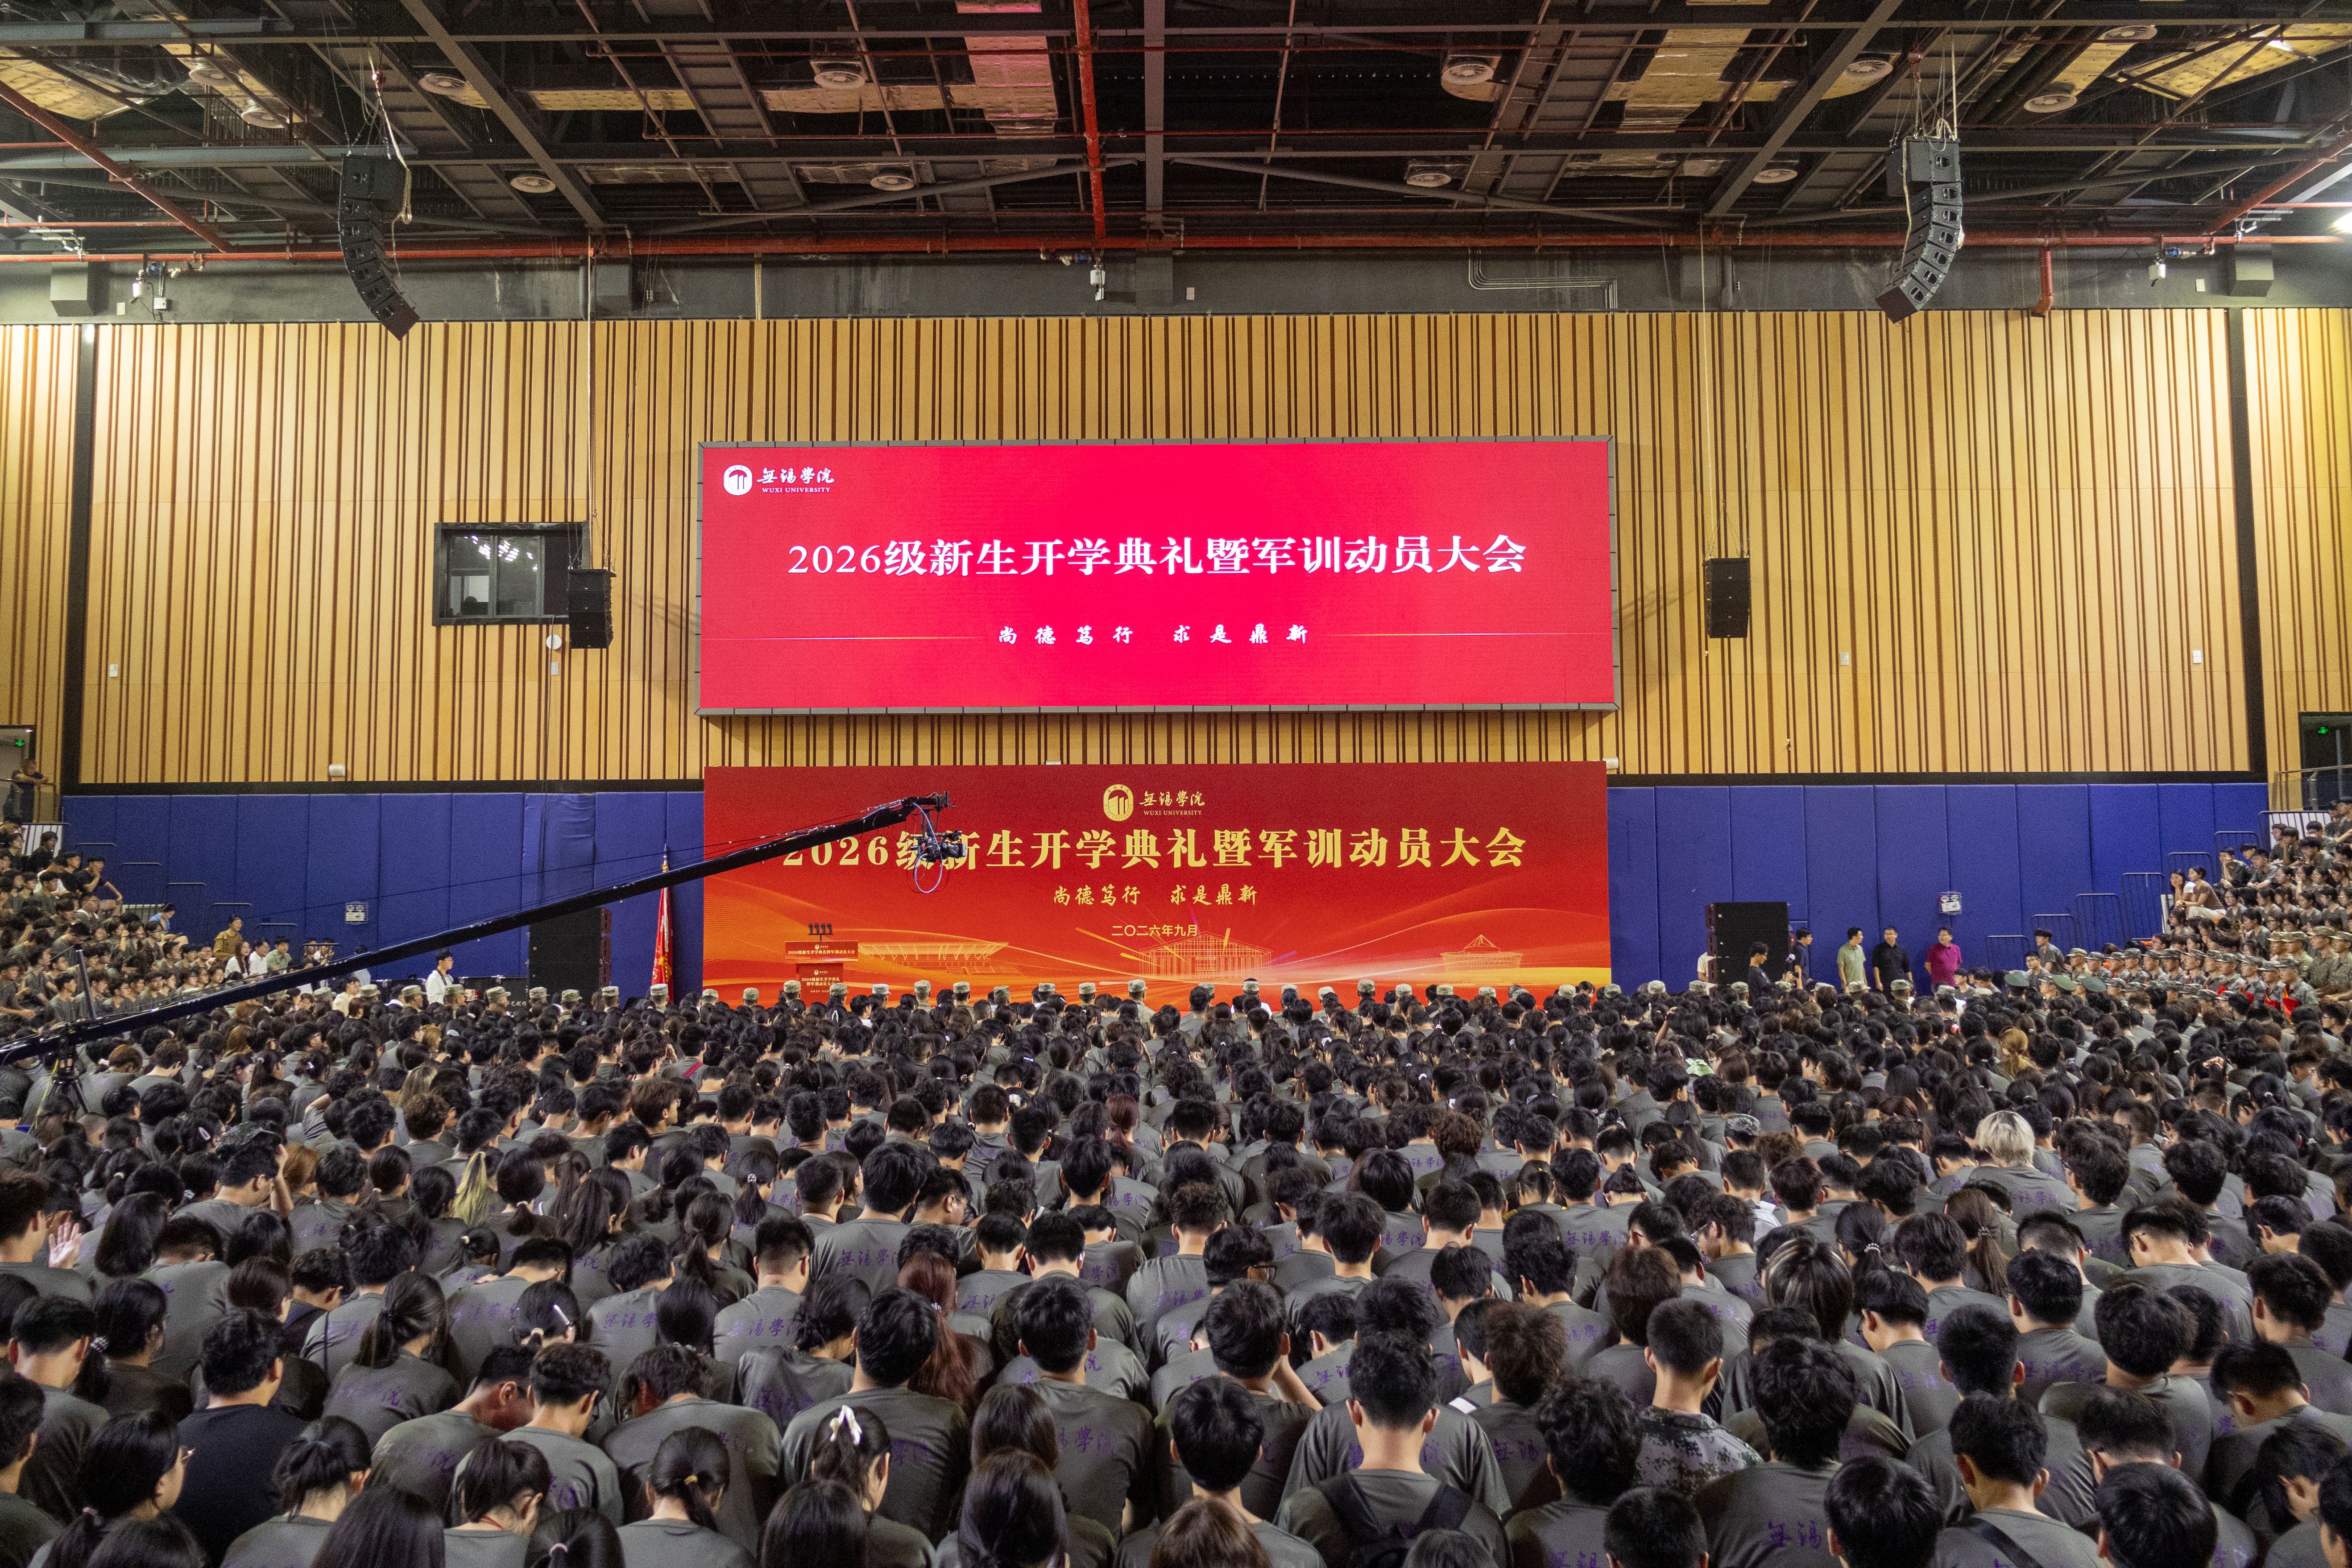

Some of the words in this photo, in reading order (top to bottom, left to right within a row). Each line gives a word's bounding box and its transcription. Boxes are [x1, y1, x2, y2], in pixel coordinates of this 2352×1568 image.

[788, 534, 1526, 576] 2026级新生开学典礼暨军训动员大会
[998, 625, 1133, 645] 尚德笃行
[1054, 884, 1140, 906] 尚德笃行
[1171, 883, 1257, 906] 求是鼎新
